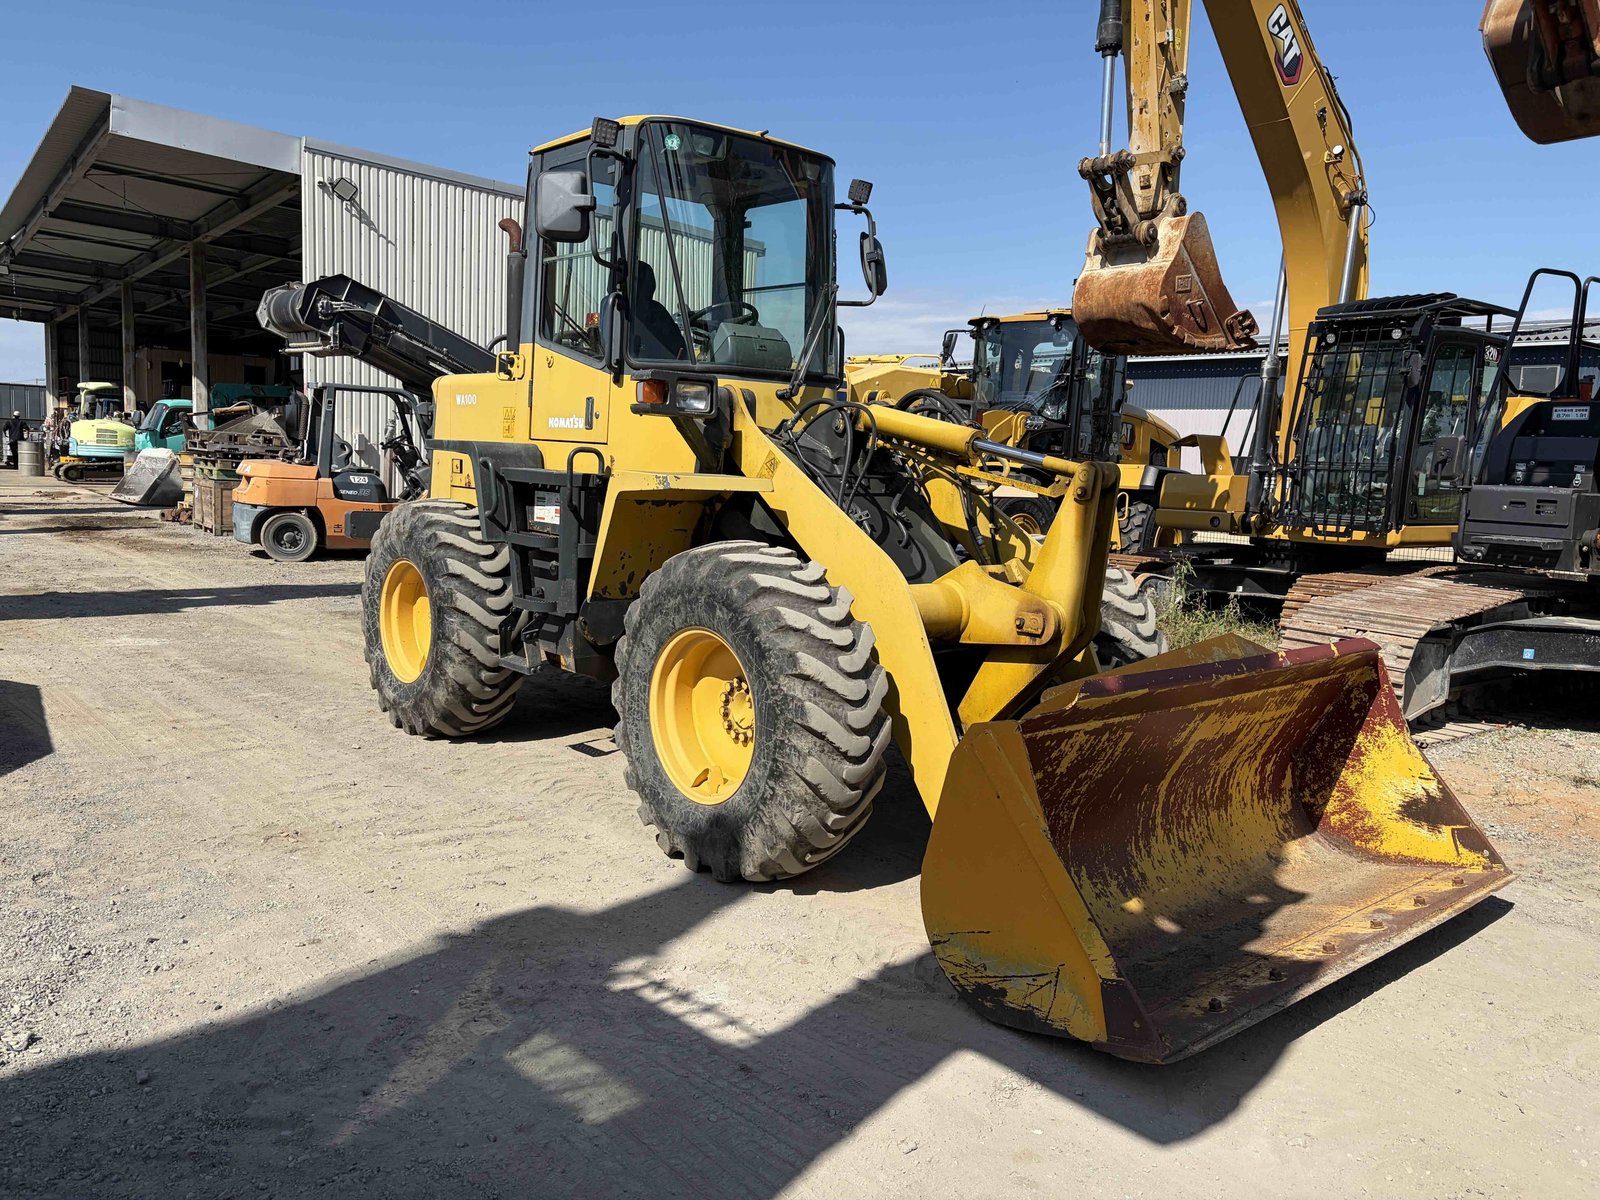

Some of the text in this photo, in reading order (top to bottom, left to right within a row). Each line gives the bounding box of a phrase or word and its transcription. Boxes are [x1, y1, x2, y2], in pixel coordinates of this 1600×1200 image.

[1267, 4, 1301, 69] CAT
[456, 394, 477, 406] WA100
[548, 414, 584, 429] KOMATSU
[1120, 423, 1133, 444] AT
